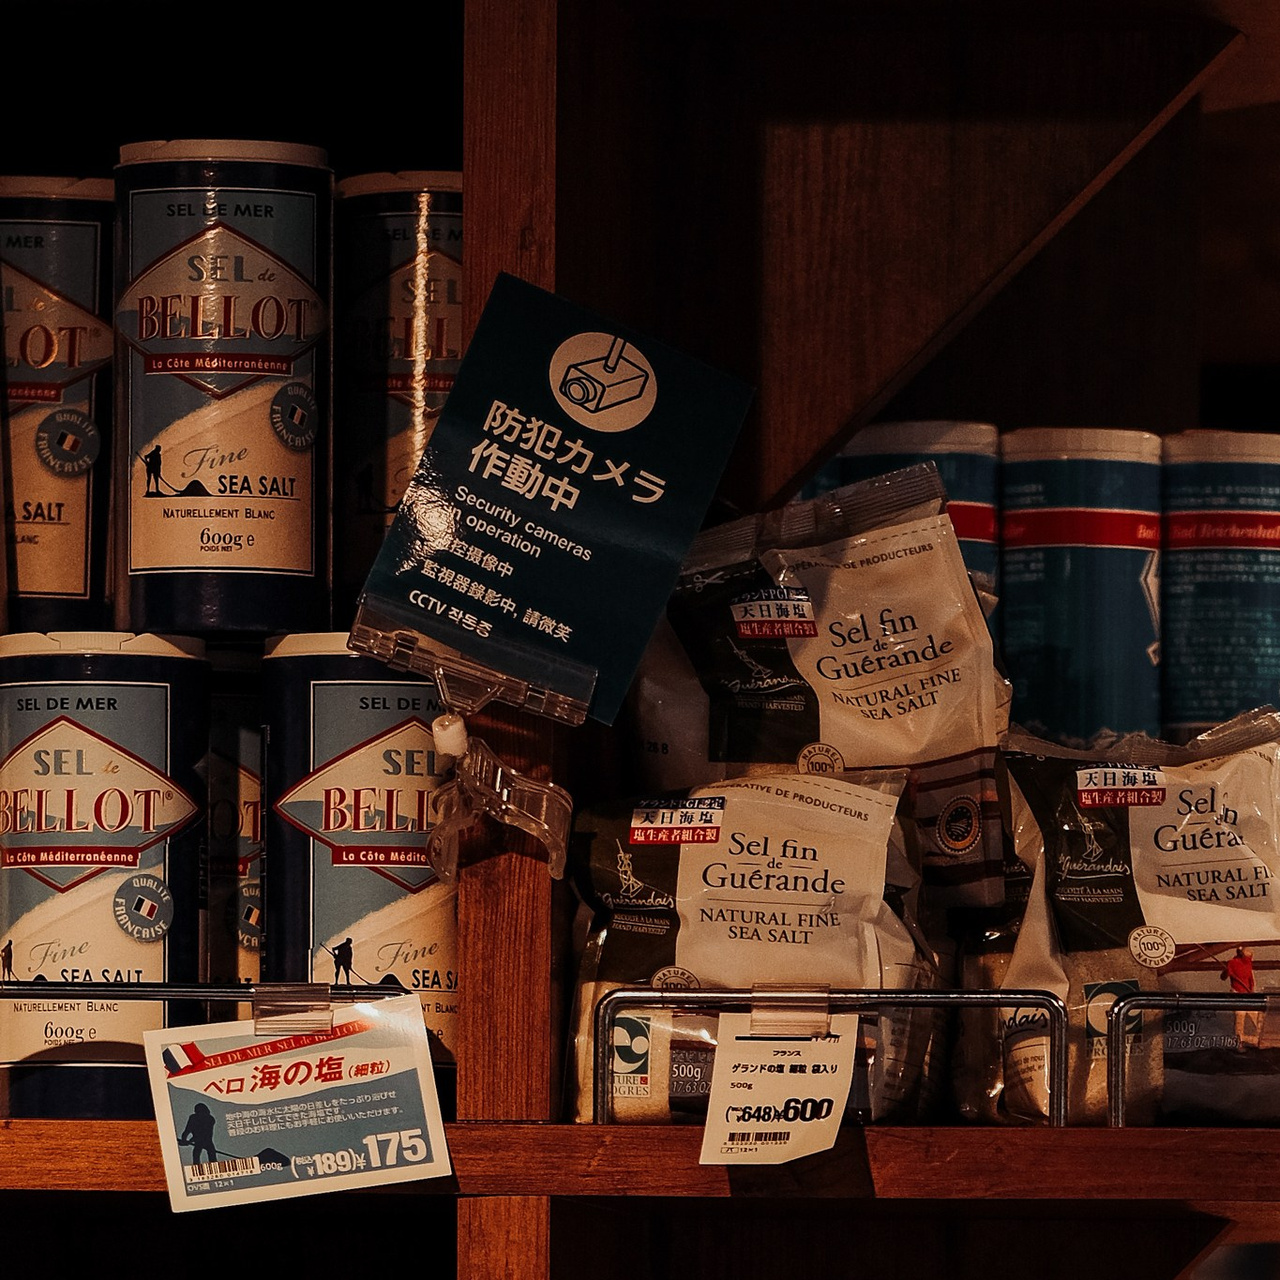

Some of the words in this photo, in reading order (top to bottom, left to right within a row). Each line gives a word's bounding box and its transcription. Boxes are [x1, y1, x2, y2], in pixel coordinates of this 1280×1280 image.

[167, 204, 194, 217] SEL
[234, 204, 274, 218] MER
[188, 255, 253, 283] SEL
[138, 296, 310, 343] BELLOT
[166, 358, 190, 370] Côte
[181, 445, 248, 478] Fine
[481, 399, 668, 504] 防犯カメラ
[467, 438, 581, 512] 作動中
[218, 476, 252, 496] SEA
[258, 477, 296, 497] SALT
[23, 502, 64, 522] SALT
[455, 485, 522, 531] Security
[524, 520, 594, 562] cameras
[200, 528, 243, 550] 600g
[466, 512, 542, 559] operation
[859, 543, 934, 568] PRODUCTEURS
[409, 590, 446, 616] CCTV
[741, 604, 808, 618] 天日海塩
[829, 615, 871, 647] Sel
[880, 608, 918, 636] fin
[873, 639, 888, 652] de
[816, 635, 954, 681] Guérande
[831, 682, 917, 706] NATURAL
[920, 668, 962, 692] FINE
[17, 698, 40, 711] SEL
[47, 698, 70, 710] DE
[76, 697, 118, 711] MER
[360, 697, 390, 711] SEL
[397, 697, 422, 711] DE
[860, 707, 892, 721] SEA
[897, 690, 940, 716] SALT
[33, 750, 94, 776] SEL
[1084, 771, 1159, 787] 天日海塩
[793, 792, 870, 822] PRODUCTEURS
[1081, 791, 1163, 805] 塩生産者組合製
[1177, 787, 1216, 816] Sel
[640, 811, 714, 825] 天日海塩
[634, 829, 717, 841] 塩生産者組合製
[16, 849, 37, 863] Côte
[40, 849, 134, 864] Méditerranéenne
[343, 851, 358, 862] La
[361, 849, 386, 863] Côte
[729, 832, 769, 857] Sel
[781, 838, 818, 861] fin
[767, 858, 783, 869] de
[702, 863, 846, 894] Guérande
[1156, 868, 1248, 888] NATURAL
[1187, 888, 1223, 902] SEA
[1226, 882, 1270, 900] SALT
[115, 896, 169, 940] FRANÇAISE
[699, 907, 792, 927] NATURAL
[798, 912, 841, 928] FINE
[728, 925, 765, 941] SEA
[767, 928, 813, 945] SALT
[1132, 928, 1170, 943] NATUREL
[28, 941, 90, 972] Fine
[376, 941, 439, 973] Fine
[412, 970, 441, 989] SEA
[13, 1002, 82, 1013] NATURELLEMENT
[86, 1002, 119, 1013] BLANC
[44, 1023, 85, 1042] 600g
[1166, 1037, 1192, 1047] 17.63
[204, 1054, 226, 1068] SEL
[229, 1050, 244, 1062] DE
[247, 1044, 272, 1060] MER
[204, 1077, 245, 1096] ベロ
[250, 1056, 344, 1093] 海の塩
[348, 1060, 391, 1079] (細粒)
[732, 1064, 785, 1074] ゲランドの塩
[730, 1082, 753, 1090] 500g
[260, 1162, 284, 1173] 600g
